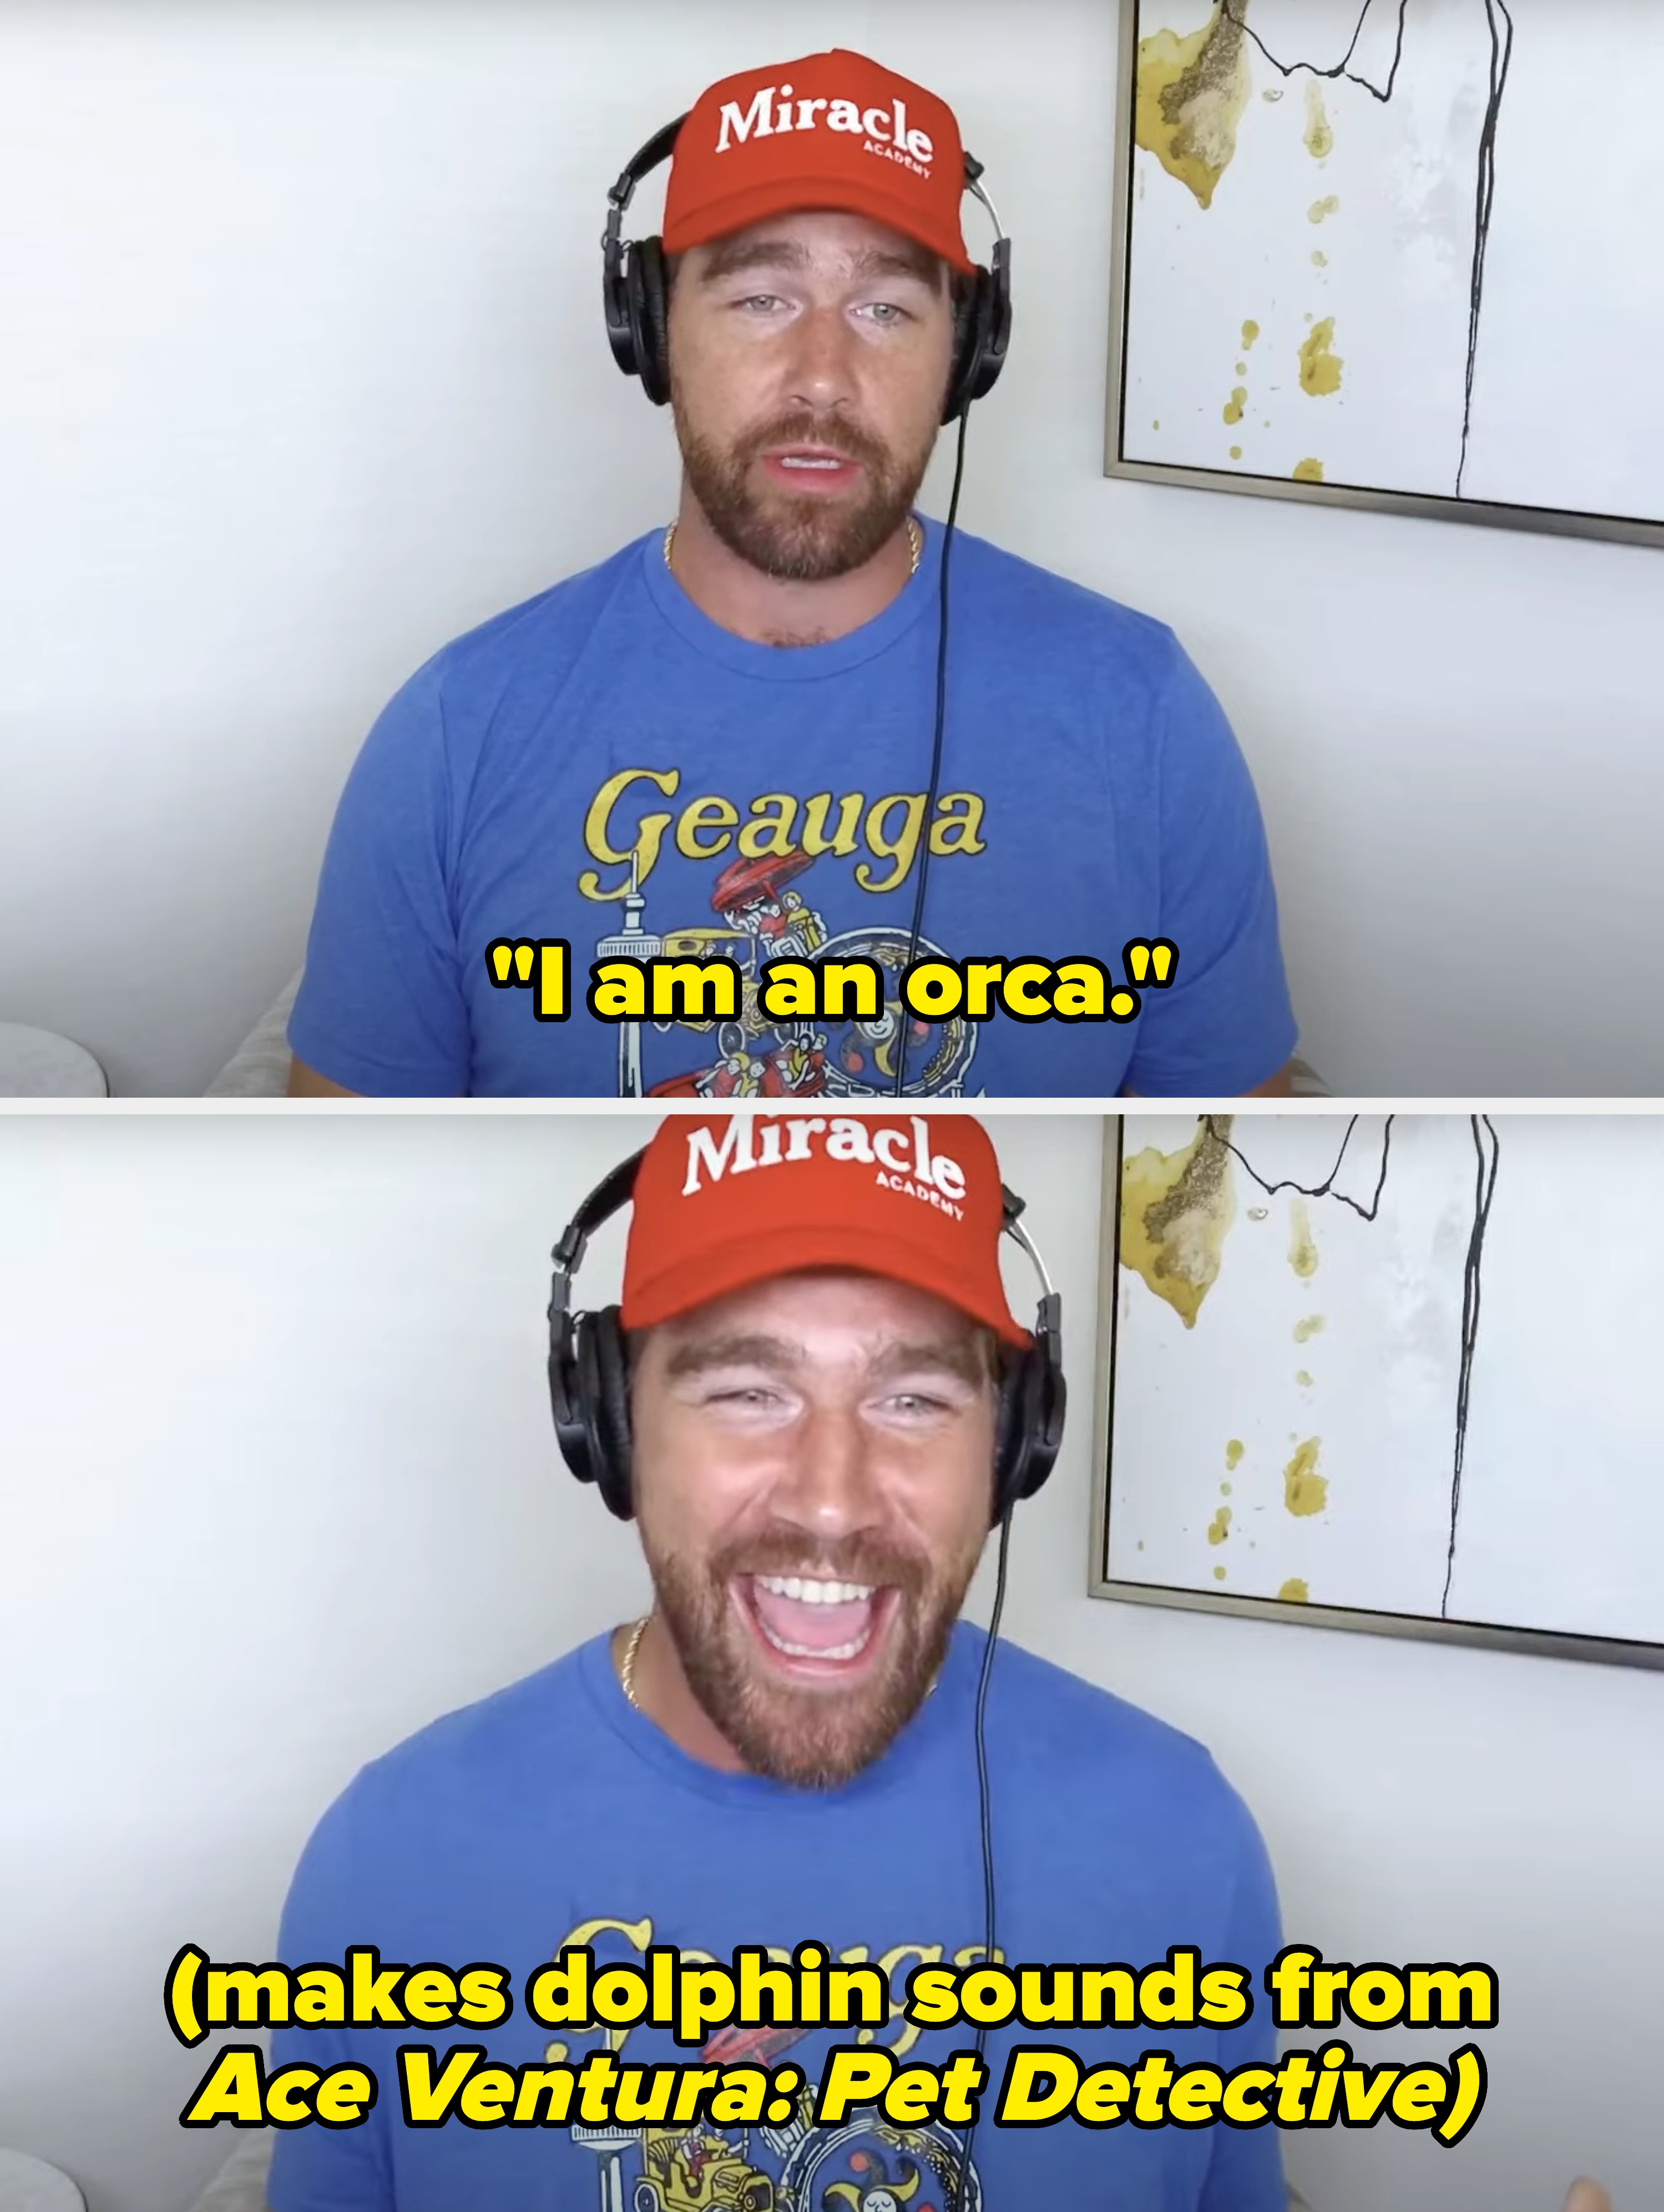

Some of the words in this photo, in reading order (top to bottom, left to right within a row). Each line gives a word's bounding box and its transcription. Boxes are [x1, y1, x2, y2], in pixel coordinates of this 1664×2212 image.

[715, 84, 934, 163] Miracle
[863, 140, 932, 179] ACADEMY
[578, 768, 987, 901] Geauga
[681, 1114, 966, 1199] Miracle
[875, 1170, 964, 1222] ACADEMY
